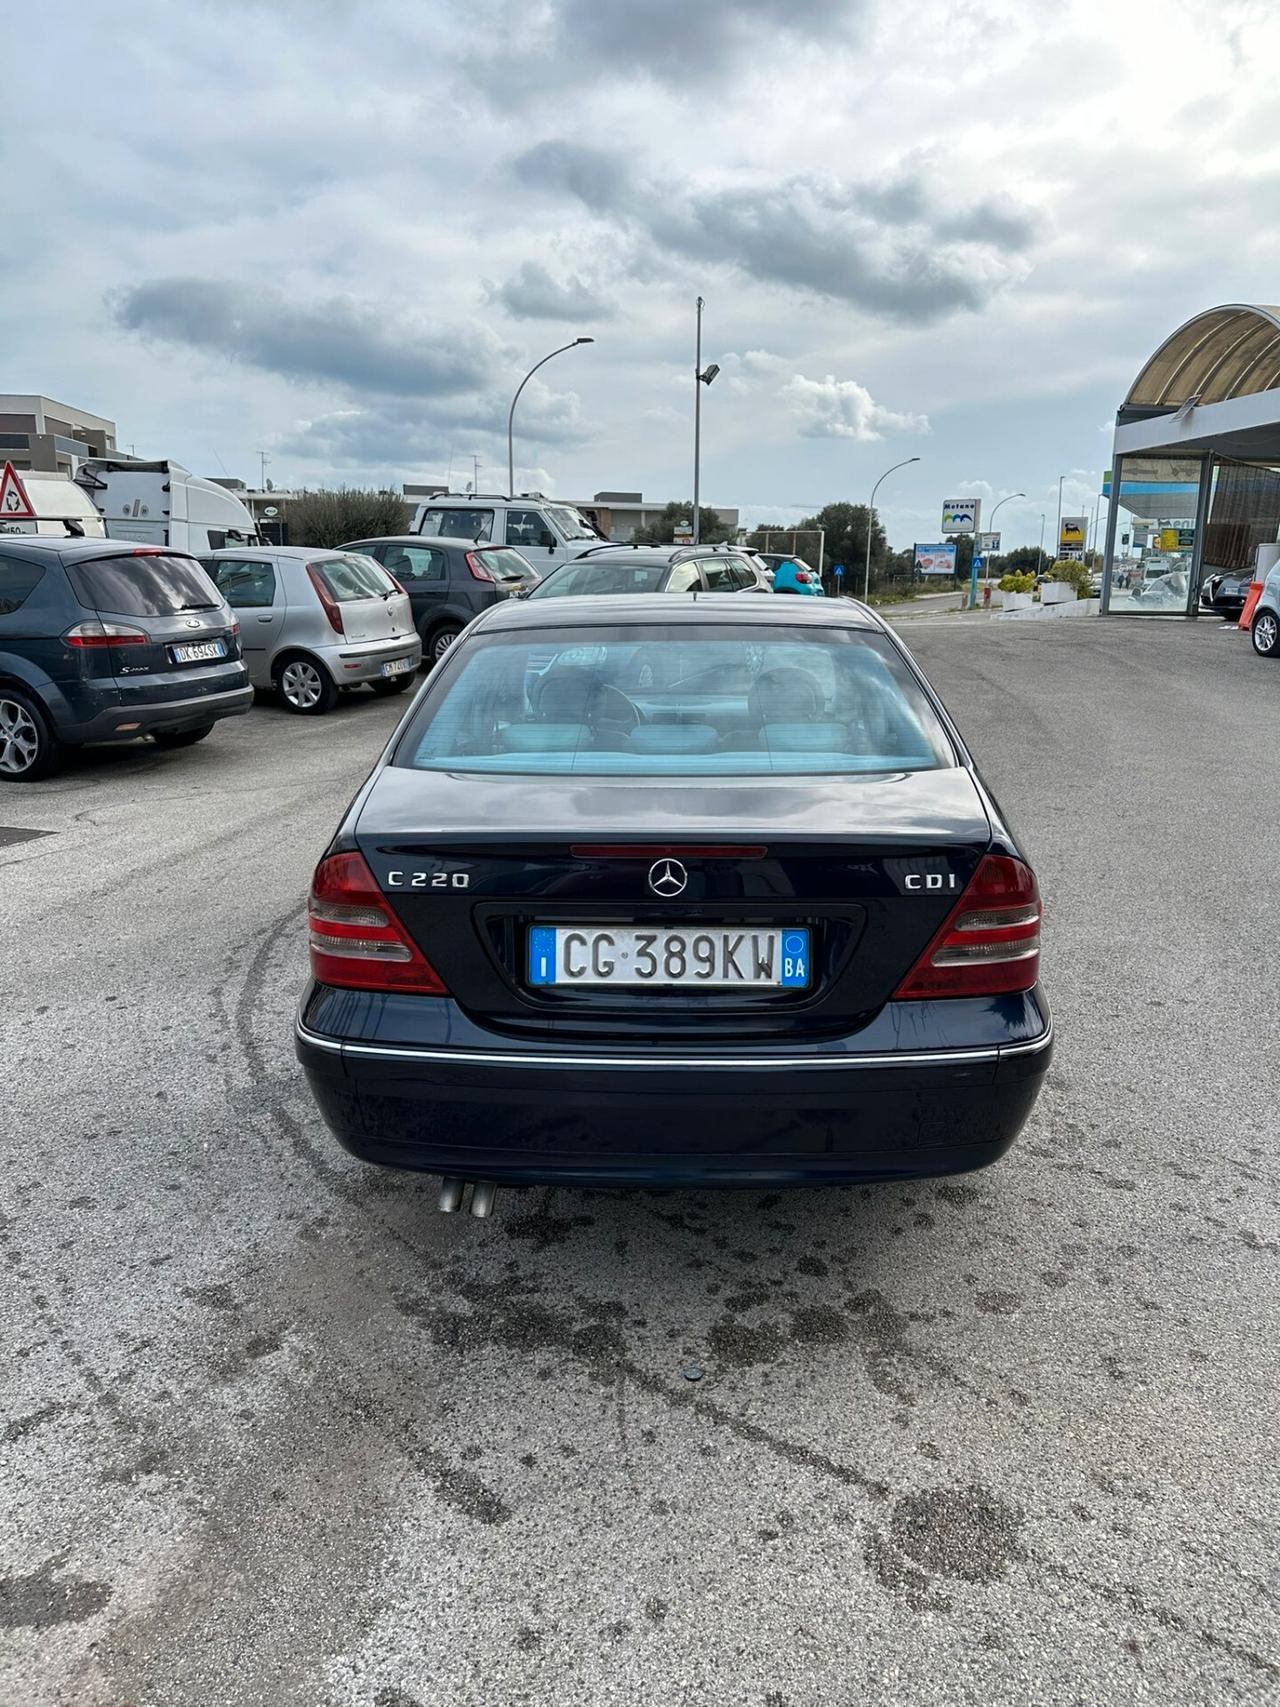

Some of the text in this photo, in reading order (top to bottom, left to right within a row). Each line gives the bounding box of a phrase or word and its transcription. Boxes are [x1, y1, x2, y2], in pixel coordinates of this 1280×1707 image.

[388, 871, 470, 888] C 220
[905, 873, 956, 889] CDI
[540, 933, 806, 979] I CG 389KW BA
